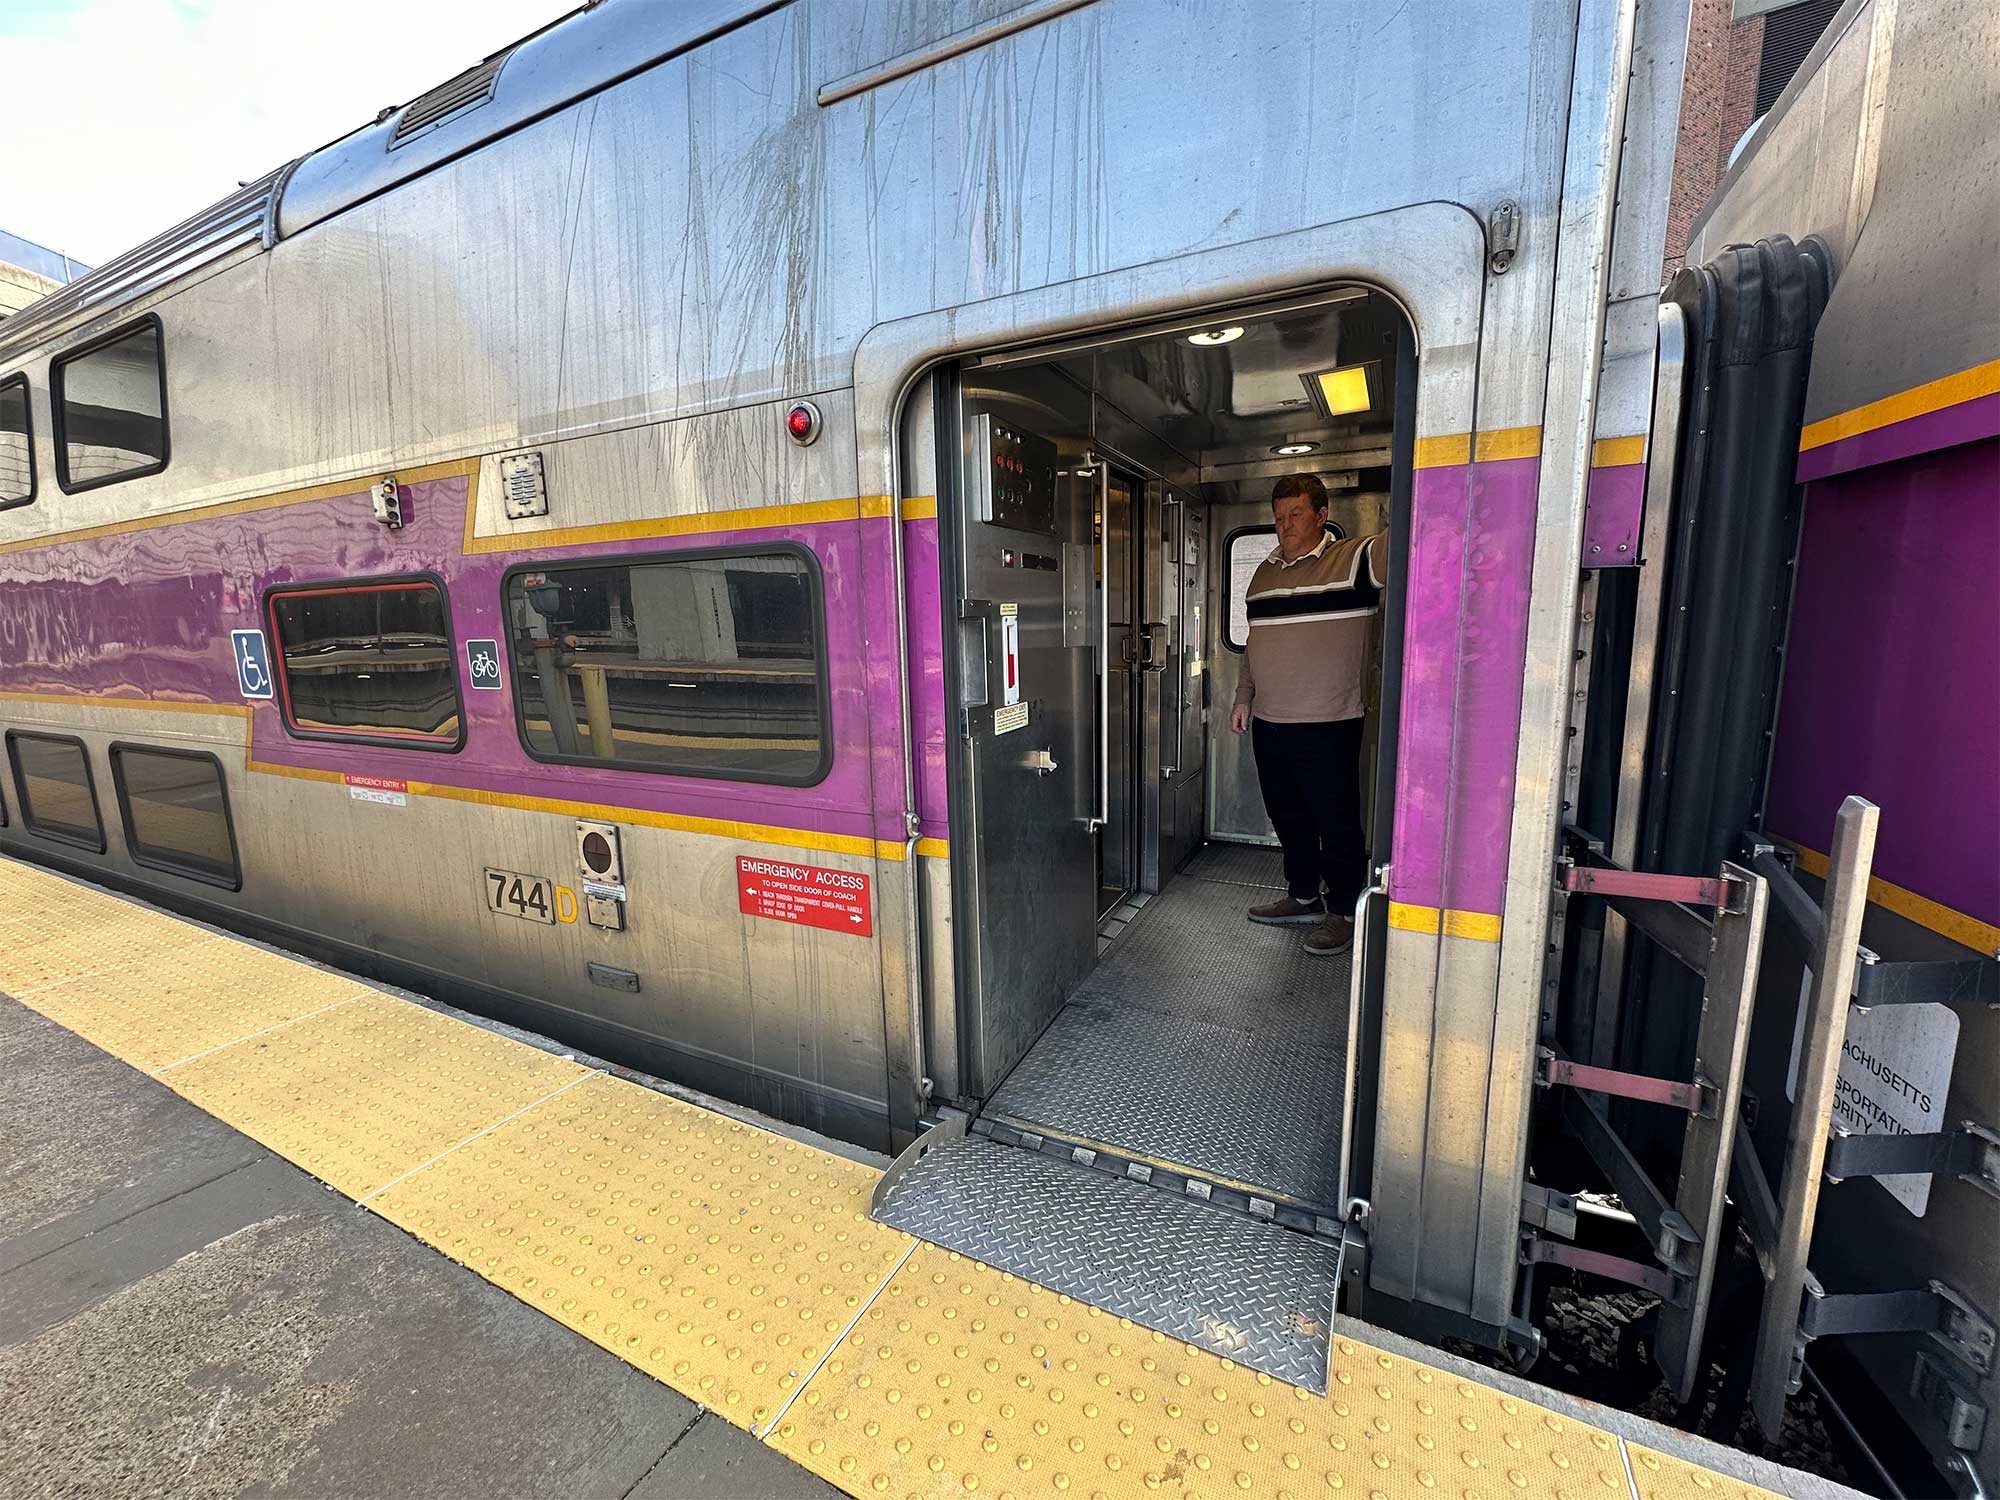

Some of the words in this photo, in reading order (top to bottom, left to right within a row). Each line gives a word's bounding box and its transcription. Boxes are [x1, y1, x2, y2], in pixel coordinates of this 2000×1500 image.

[351, 776, 382, 787] EMERGENCY
[383, 780, 400, 789] ENTRY
[741, 859, 810, 881] EMERGENCY
[815, 871, 864, 890] ACCESS
[762, 879, 771, 887] TO
[771, 881, 789, 890] OPEN
[788, 883, 803, 893] SIDE
[803, 886, 822, 896] DOOR
[822, 889, 833, 897] OF
[833, 891, 857, 902] COACH
[489, 873, 548, 918] 744
[554, 884, 579, 925] D
[1842, 1039, 1932, 1113] ACHUSETTS
[1832, 1093, 1873, 1135] ORITY
